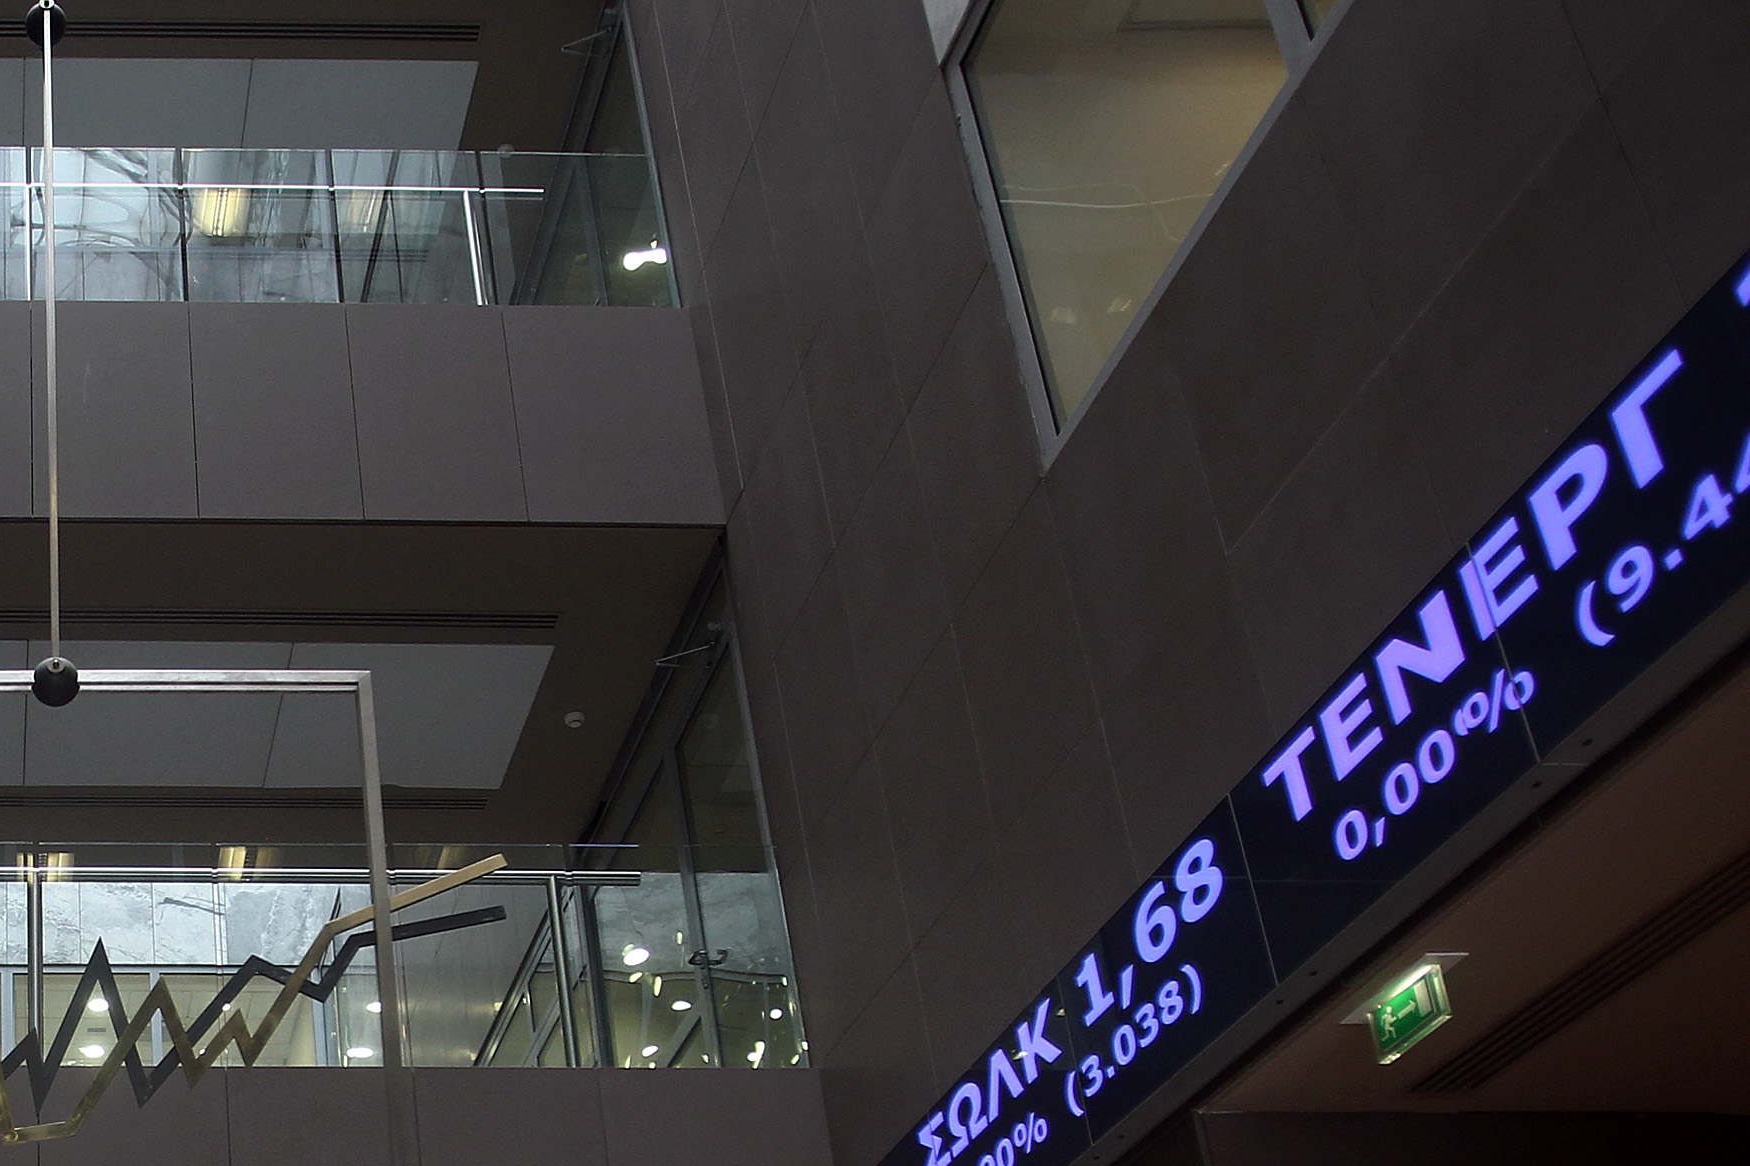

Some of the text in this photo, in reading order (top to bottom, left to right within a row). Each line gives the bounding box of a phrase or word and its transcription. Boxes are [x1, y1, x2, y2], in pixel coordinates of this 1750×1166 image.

[1064, 963, 1203, 1119] (3.038)
[1333, 668, 1537, 862] 0,00%
[1075, 838, 1224, 1027] 1,68
[1261, 348, 1684, 823] ΤΕΝΕΡΓ
